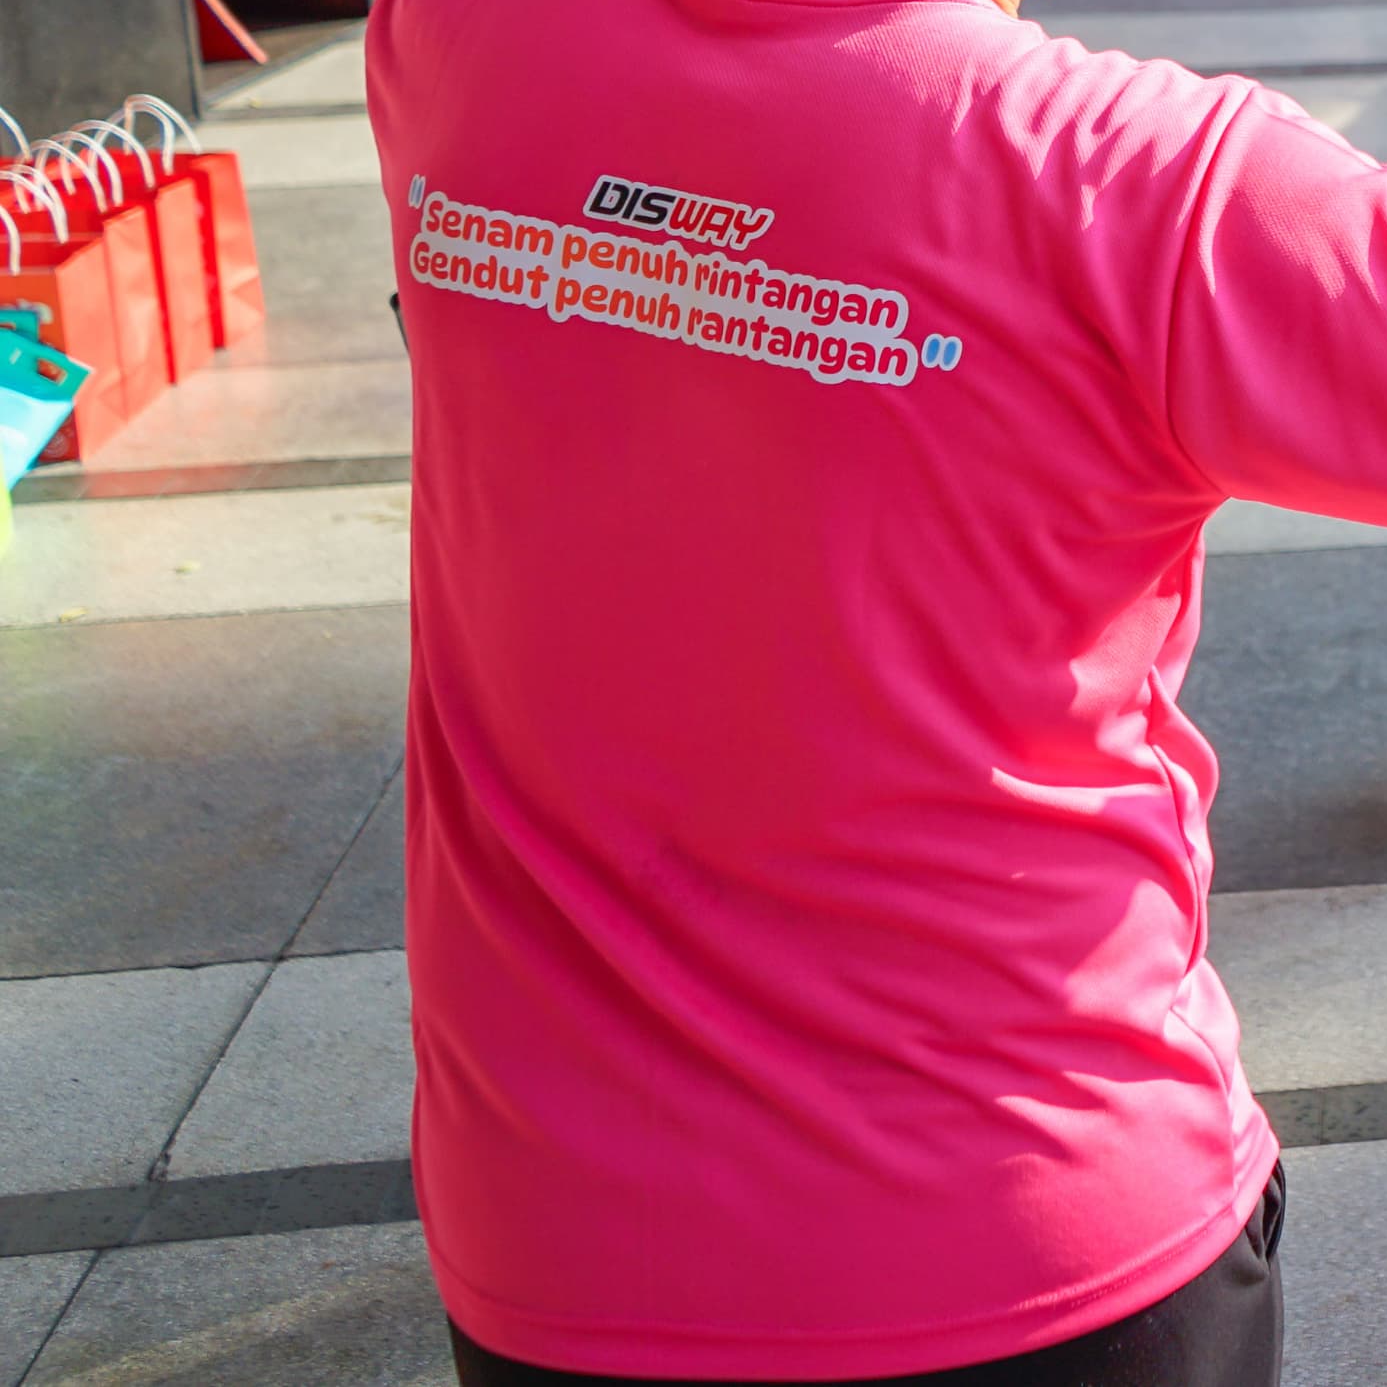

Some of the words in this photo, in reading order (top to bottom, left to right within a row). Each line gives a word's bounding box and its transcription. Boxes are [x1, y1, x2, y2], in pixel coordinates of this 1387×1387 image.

[588, 180, 769, 244] DISWAY
[413, 241, 550, 300] Gendut
[555, 276, 682, 331] penuh
[561, 232, 689, 287] penuh
[694, 260, 900, 329] rintangan
